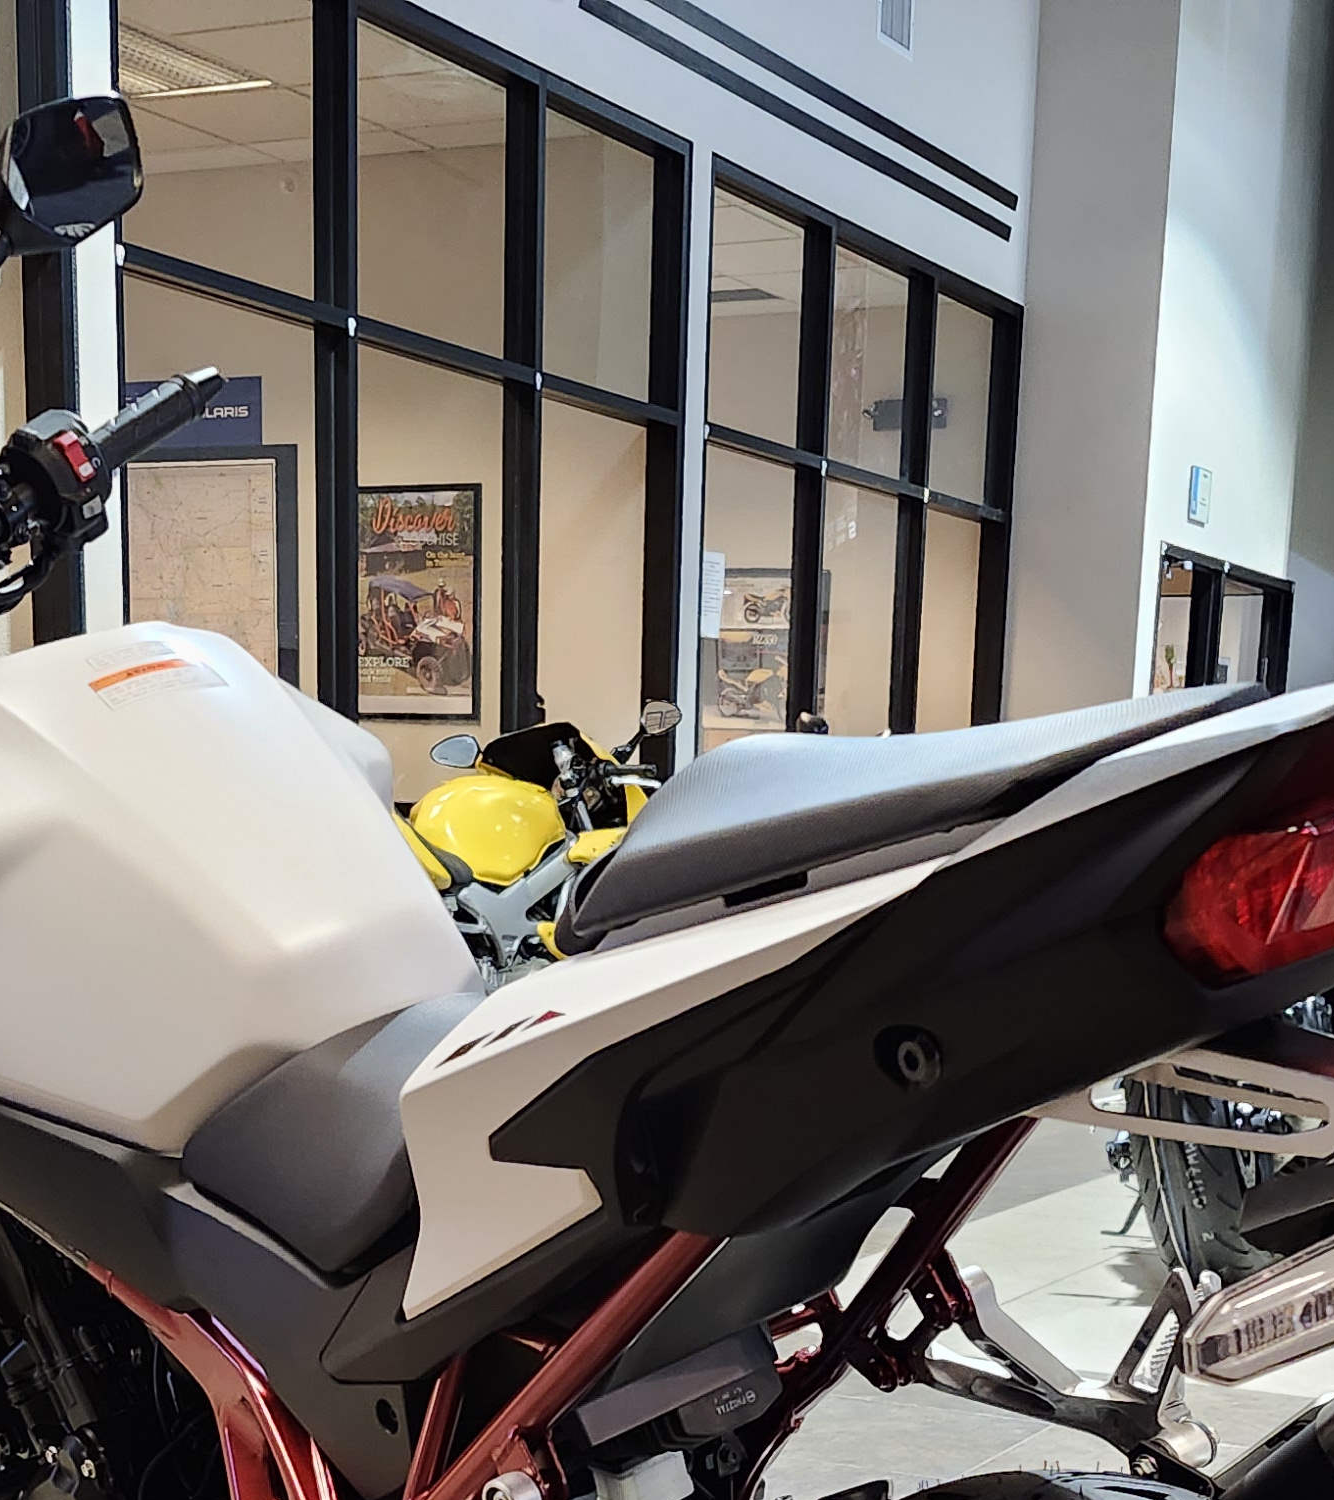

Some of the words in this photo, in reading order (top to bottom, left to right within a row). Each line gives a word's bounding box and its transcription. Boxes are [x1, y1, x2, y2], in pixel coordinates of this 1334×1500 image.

[202, 405, 250, 419] LARIS
[373, 496, 455, 535] Discover
[358, 655, 410, 668] EXPLORE
